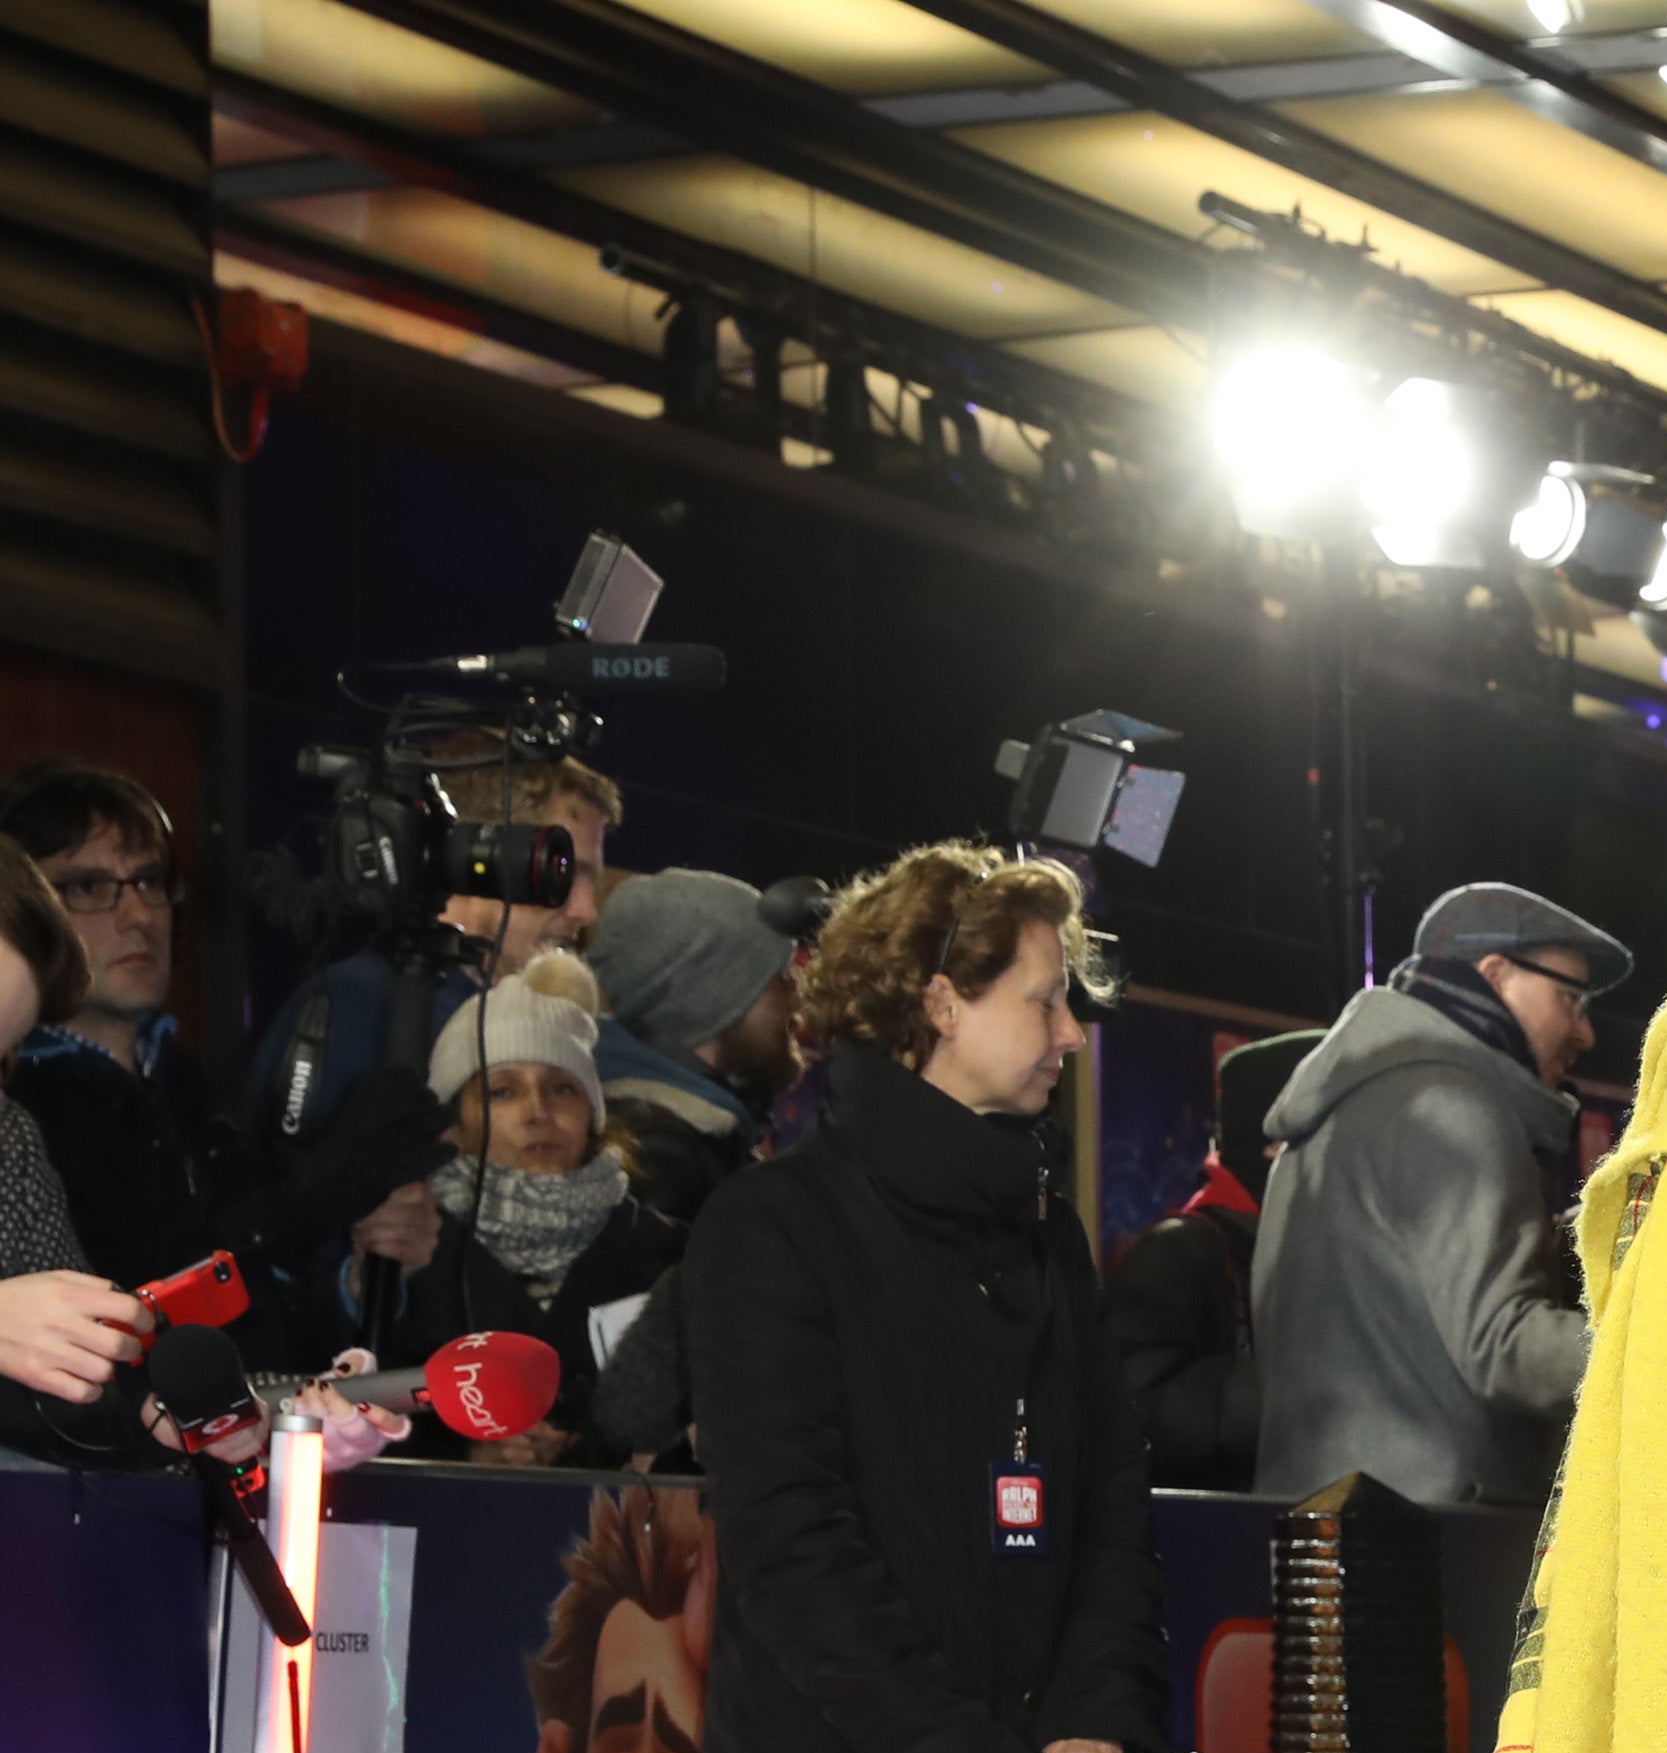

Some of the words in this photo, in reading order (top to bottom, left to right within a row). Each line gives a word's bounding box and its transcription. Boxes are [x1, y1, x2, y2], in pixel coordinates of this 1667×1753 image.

[281, 1060, 312, 1135] Canon
[453, 1362, 508, 1437] heart
[1006, 1534, 1036, 1547] AAA
[316, 1632, 368, 1653] CLUSTER
